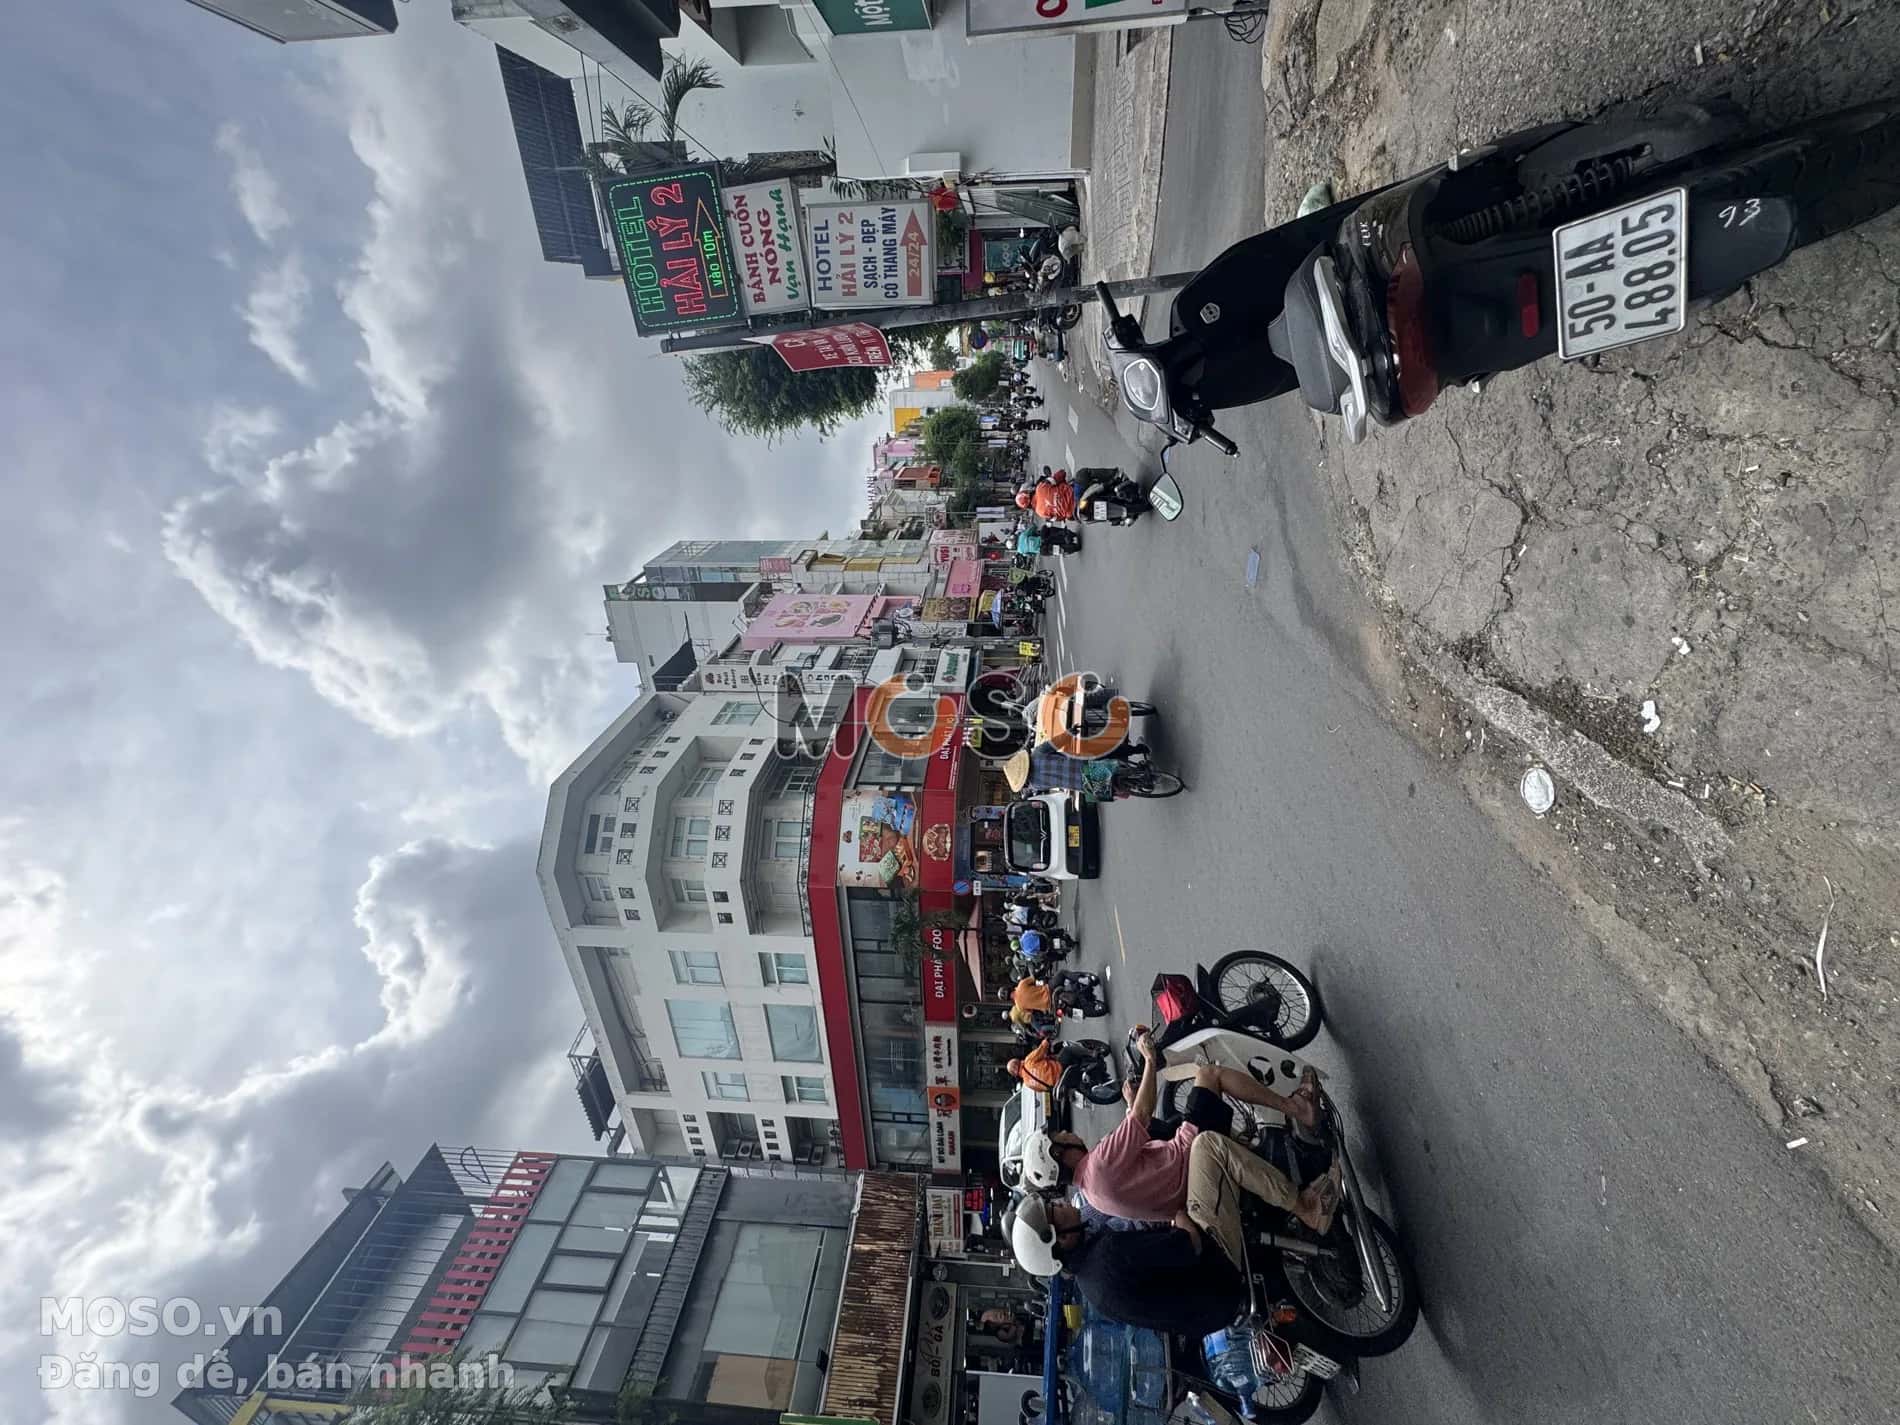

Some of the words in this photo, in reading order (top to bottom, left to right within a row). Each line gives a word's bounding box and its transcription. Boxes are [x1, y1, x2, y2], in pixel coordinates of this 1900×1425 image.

[854, 0, 893, 26] Một
[650, 184, 683, 205] 2
[646, 216, 692, 250] LÝ
[768, 188, 792, 252] Hạnh
[838, 212, 854, 224] 2
[861, 220, 879, 243] ĐẸP
[878, 207, 896, 234] MÁY
[618, 196, 665, 313] HOTEL
[703, 230, 717, 258] 10m
[757, 208, 782, 284] NÓNG
[814, 220, 832, 291] HOTEL
[836, 232, 855, 256] LÝ
[882, 238, 898, 280] THANG
[907, 231, 920, 278] 24/24
[709, 264, 722, 287] vào
[744, 252, 766, 303] BÁNH
[784, 261, 801, 300] Vạn
[836, 263, 858, 296] HẢI
[862, 256, 880, 288] SẠCH
[1622, 204, 1676, 330] 488.05
[660, 258, 707, 315] HẢI
[880, 283, 898, 298] CÓ
[1564, 232, 1616, 339] 50-AA
[864, 346, 884, 363] TRÊN
[940, 748, 952, 759] ĐẠI
[931, 923, 942, 950] FOO
[935, 981, 947, 998] ĐẠI
